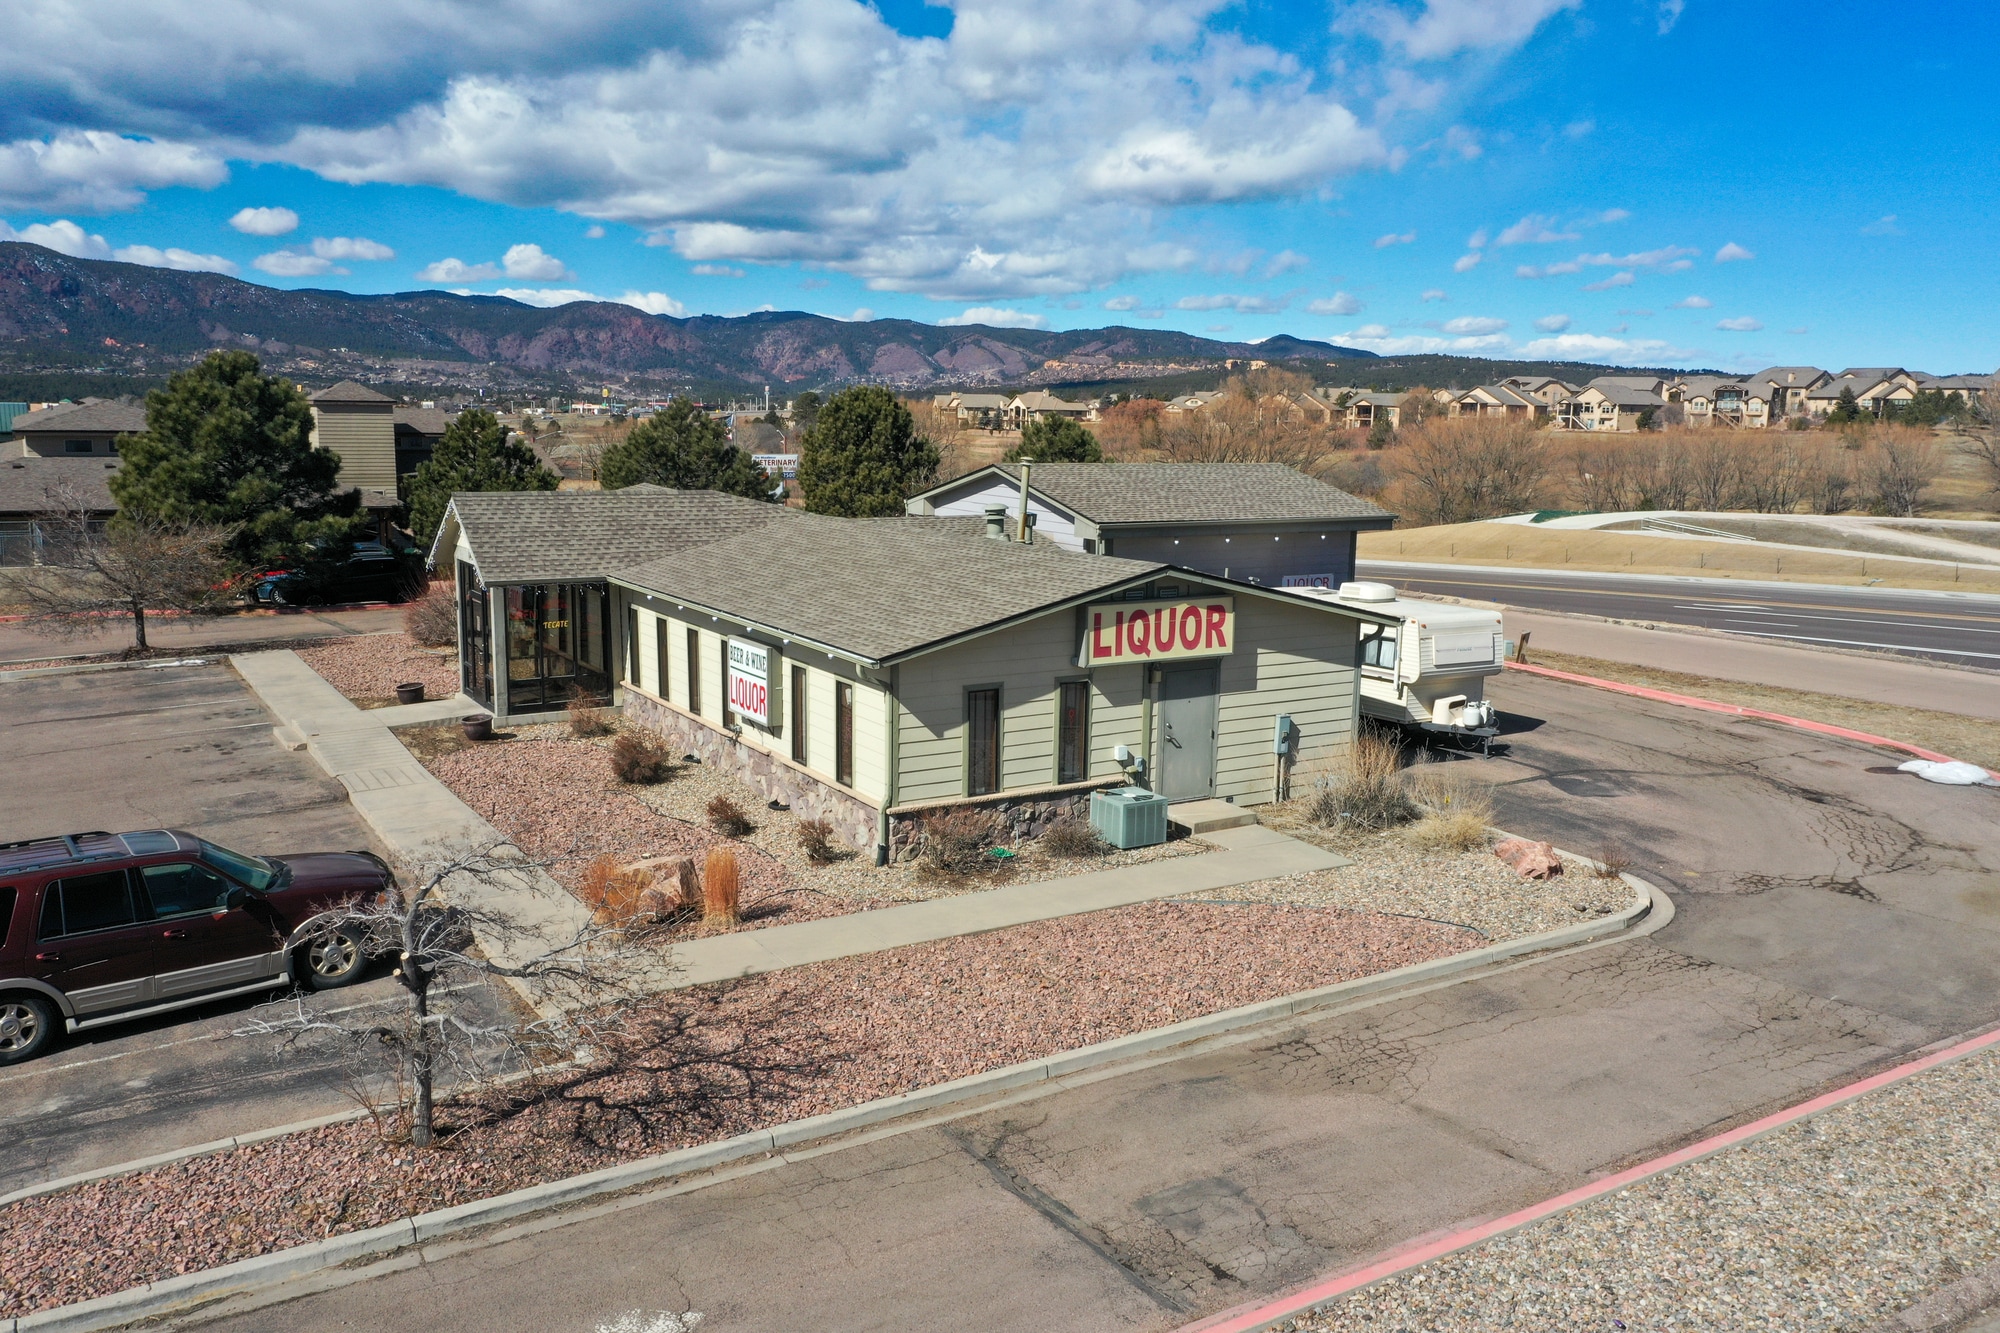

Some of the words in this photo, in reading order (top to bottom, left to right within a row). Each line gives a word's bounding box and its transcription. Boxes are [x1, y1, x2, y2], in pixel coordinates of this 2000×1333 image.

[543, 620, 569, 629] TECATE
[1093, 604, 1227, 658] LIQUOR
[730, 645, 744, 664] BEER
[746, 651, 750, 666] &
[751, 652, 767, 673] WINE
[730, 674, 767, 717] LIQUOR
